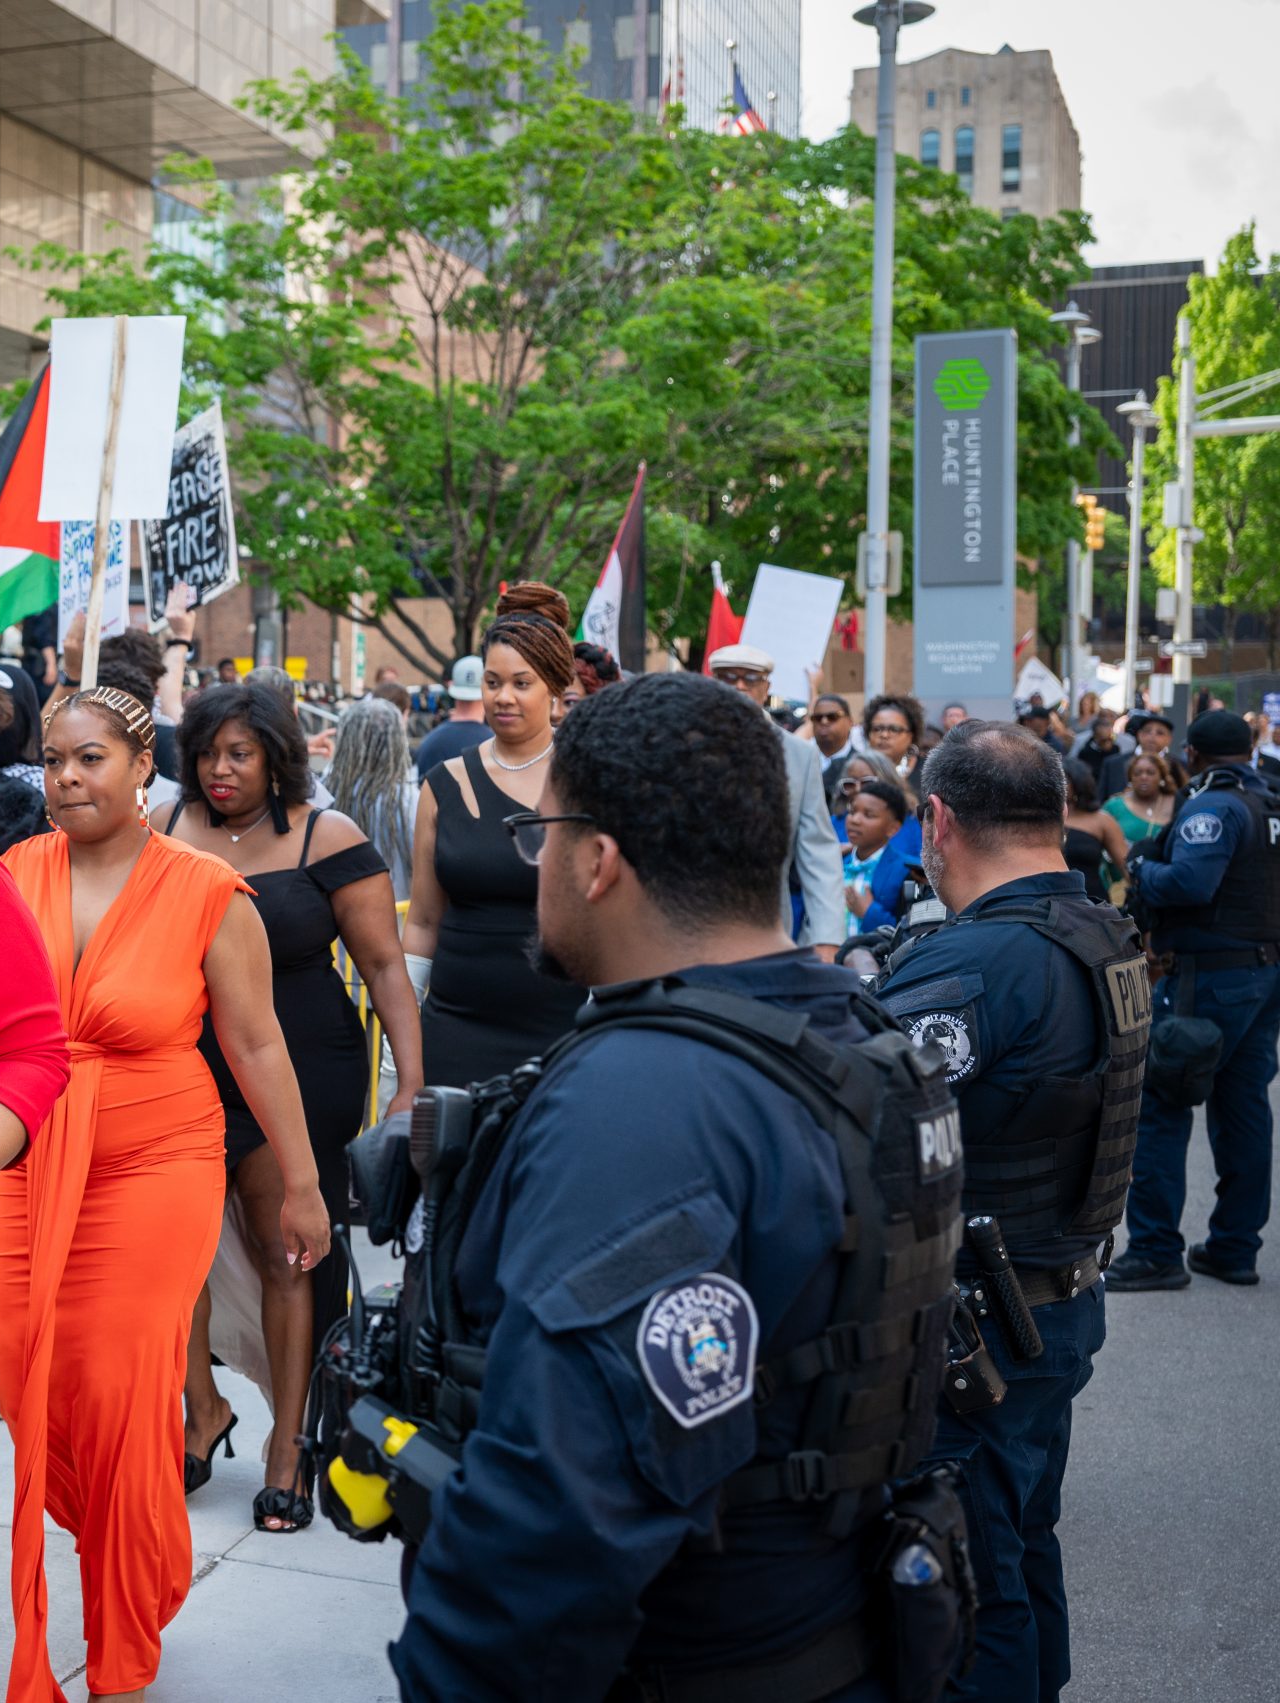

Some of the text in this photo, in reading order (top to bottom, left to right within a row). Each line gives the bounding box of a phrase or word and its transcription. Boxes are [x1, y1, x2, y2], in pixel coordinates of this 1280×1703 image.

[166, 452, 224, 519] EASE
[941, 418, 960, 486] PLACE
[963, 418, 982, 563] HUNTINGTON
[165, 507, 218, 577] FIRE
[909, 1013, 969, 1037] DETROIT POLICE
[957, 1054, 976, 1078] FORCE
[646, 1283, 741, 1350] DETROIT
[685, 1374, 742, 1416] POLICE
